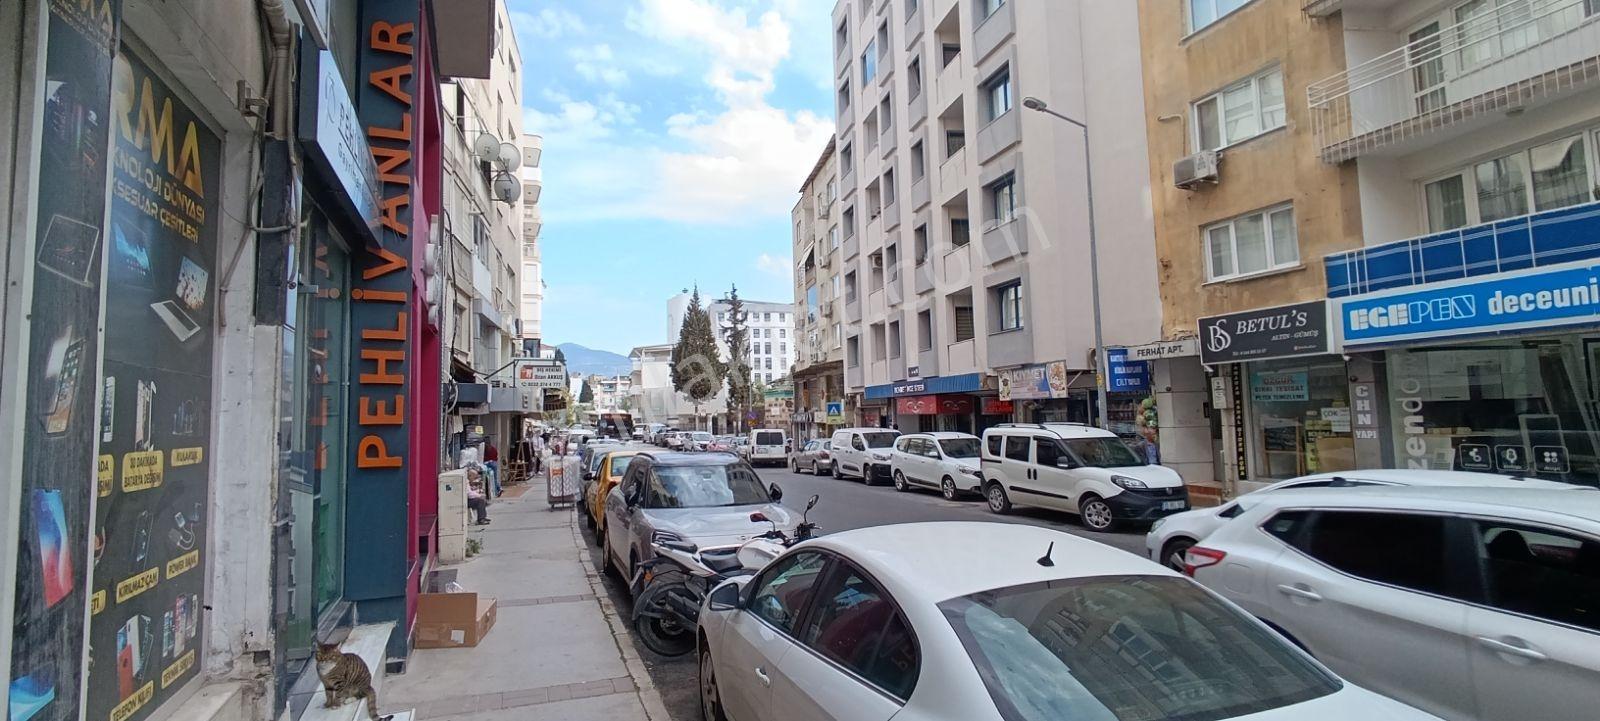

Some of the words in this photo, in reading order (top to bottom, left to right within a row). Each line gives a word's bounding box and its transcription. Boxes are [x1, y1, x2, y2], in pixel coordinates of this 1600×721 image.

[352, 20, 414, 468] PEHLİVANLAR
[1350, 294, 1476, 331] EGEPEN
[1488, 277, 1600, 316] deceuni
[1236, 310, 1308, 335] BETUL'S
[1137, 347, 1166, 357] FERHAT
[1167, 345, 1184, 354] APT.
[1355, 385, 1372, 425] CHN
[1355, 430, 1377, 439] YAPI
